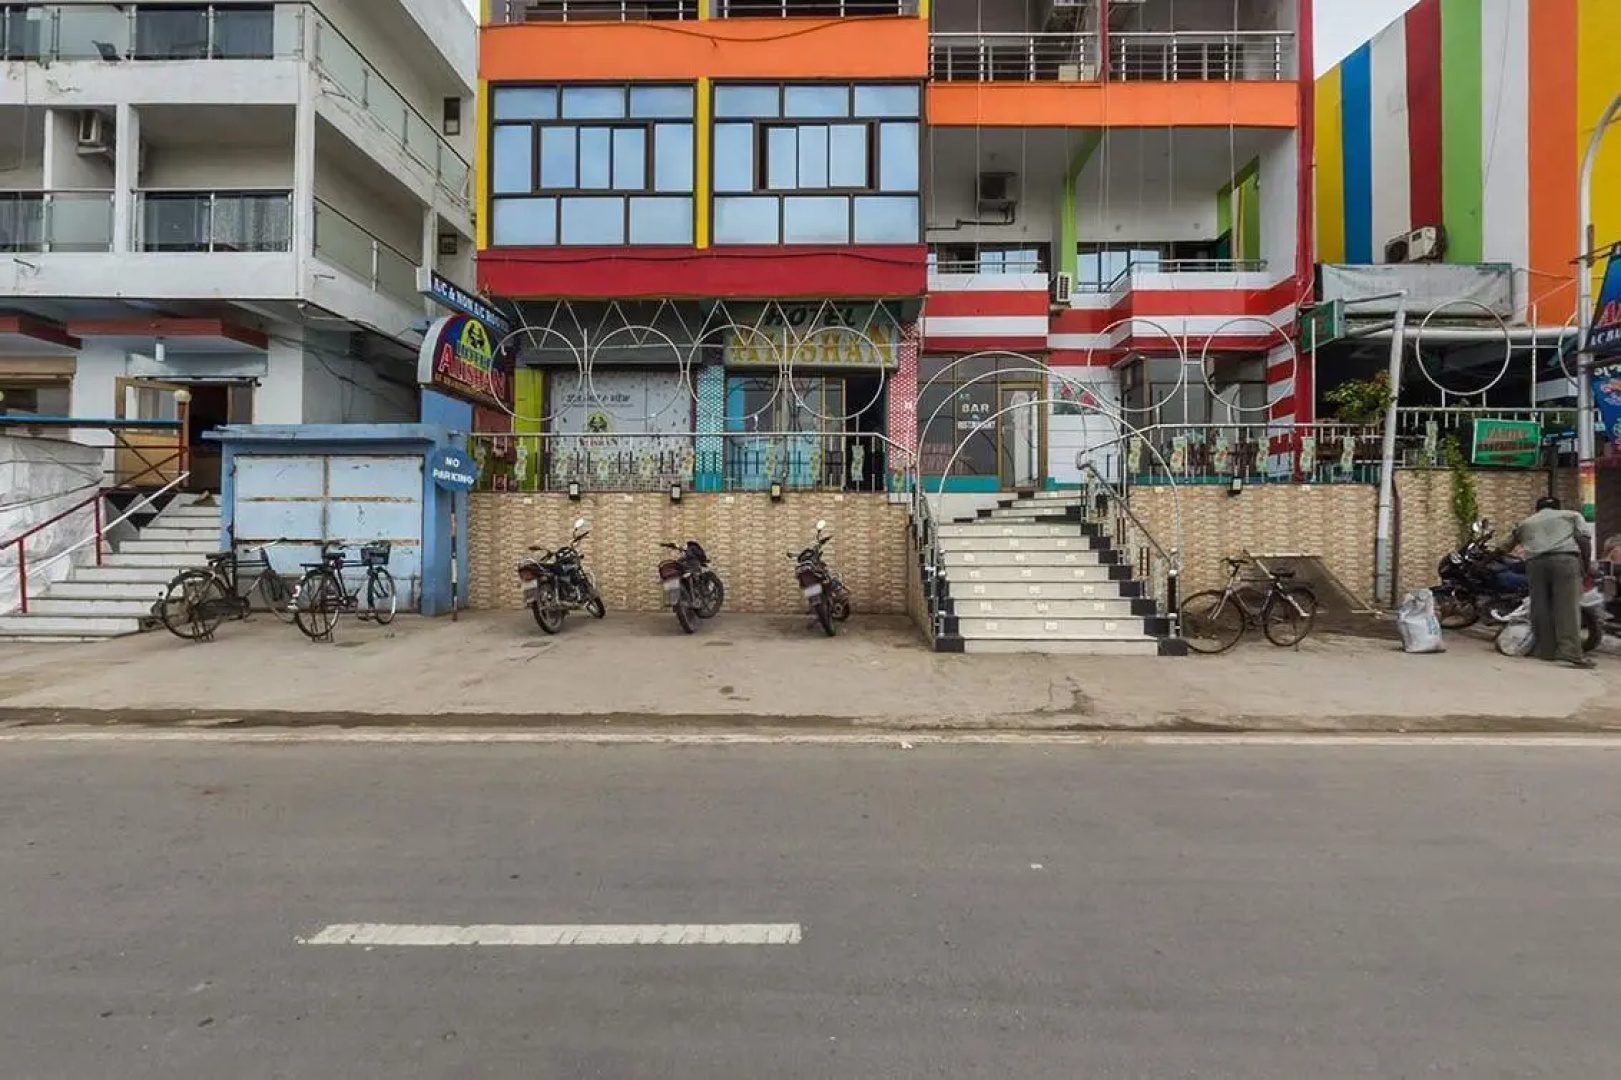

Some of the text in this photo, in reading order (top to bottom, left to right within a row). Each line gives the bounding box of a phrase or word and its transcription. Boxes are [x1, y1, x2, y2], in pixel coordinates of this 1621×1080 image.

[765, 304, 857, 327] HOTEL
[456, 339, 492, 374] HOTEL
[438, 343, 505, 400] ALISHAN
[961, 403, 990, 414] BAR
[444, 457, 460, 467] NO
[433, 468, 474, 485] PARKING
